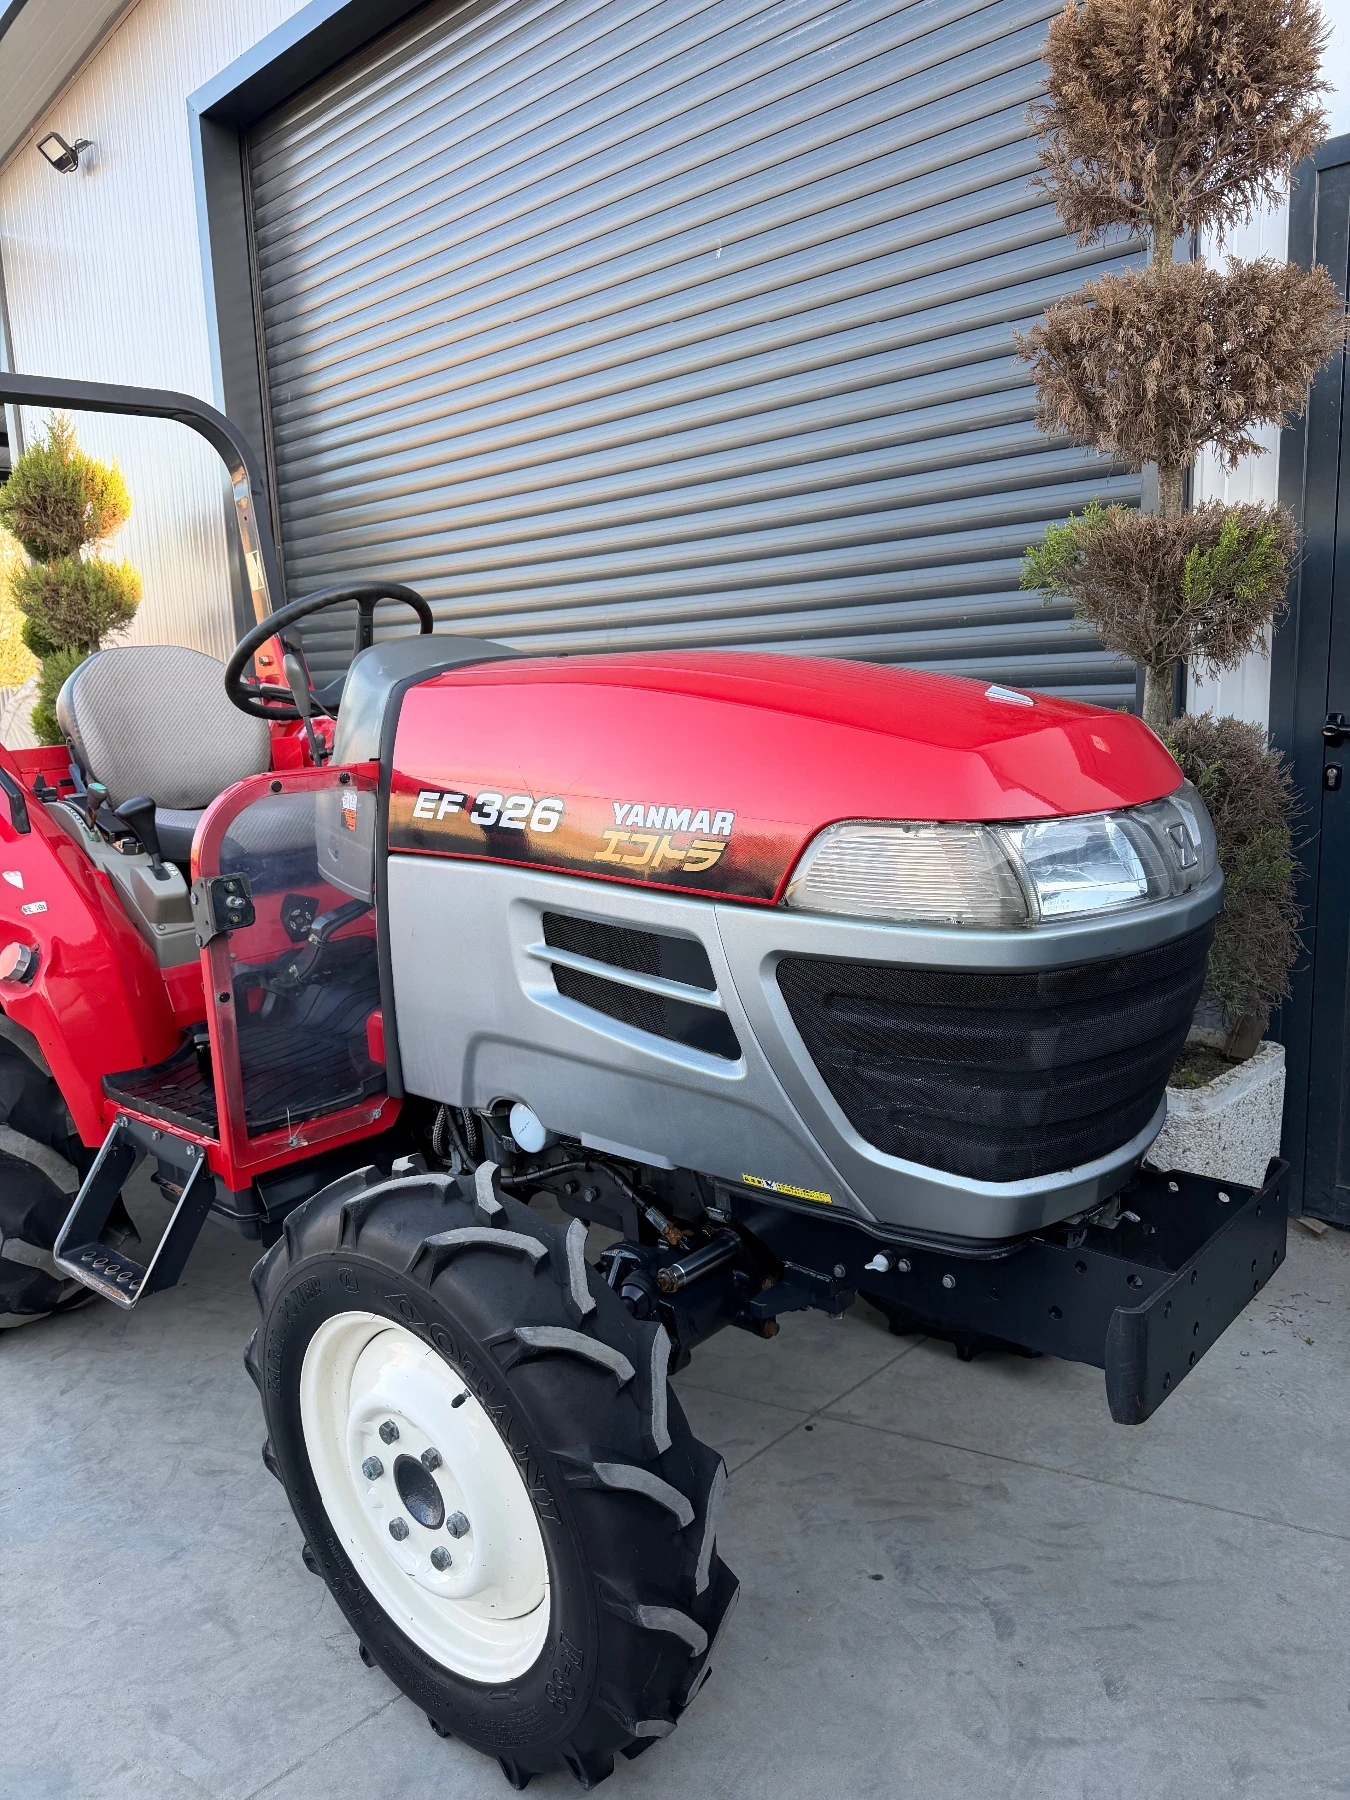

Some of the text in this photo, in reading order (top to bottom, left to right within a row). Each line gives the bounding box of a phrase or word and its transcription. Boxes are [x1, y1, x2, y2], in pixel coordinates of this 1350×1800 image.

[413, 791, 566, 833] EF 326
[612, 802, 735, 836] YANMAR
[594, 829, 729, 873] エコトラ
[278, 1275, 326, 1329] POWER
[428, 1321, 564, 1526] OTANI
